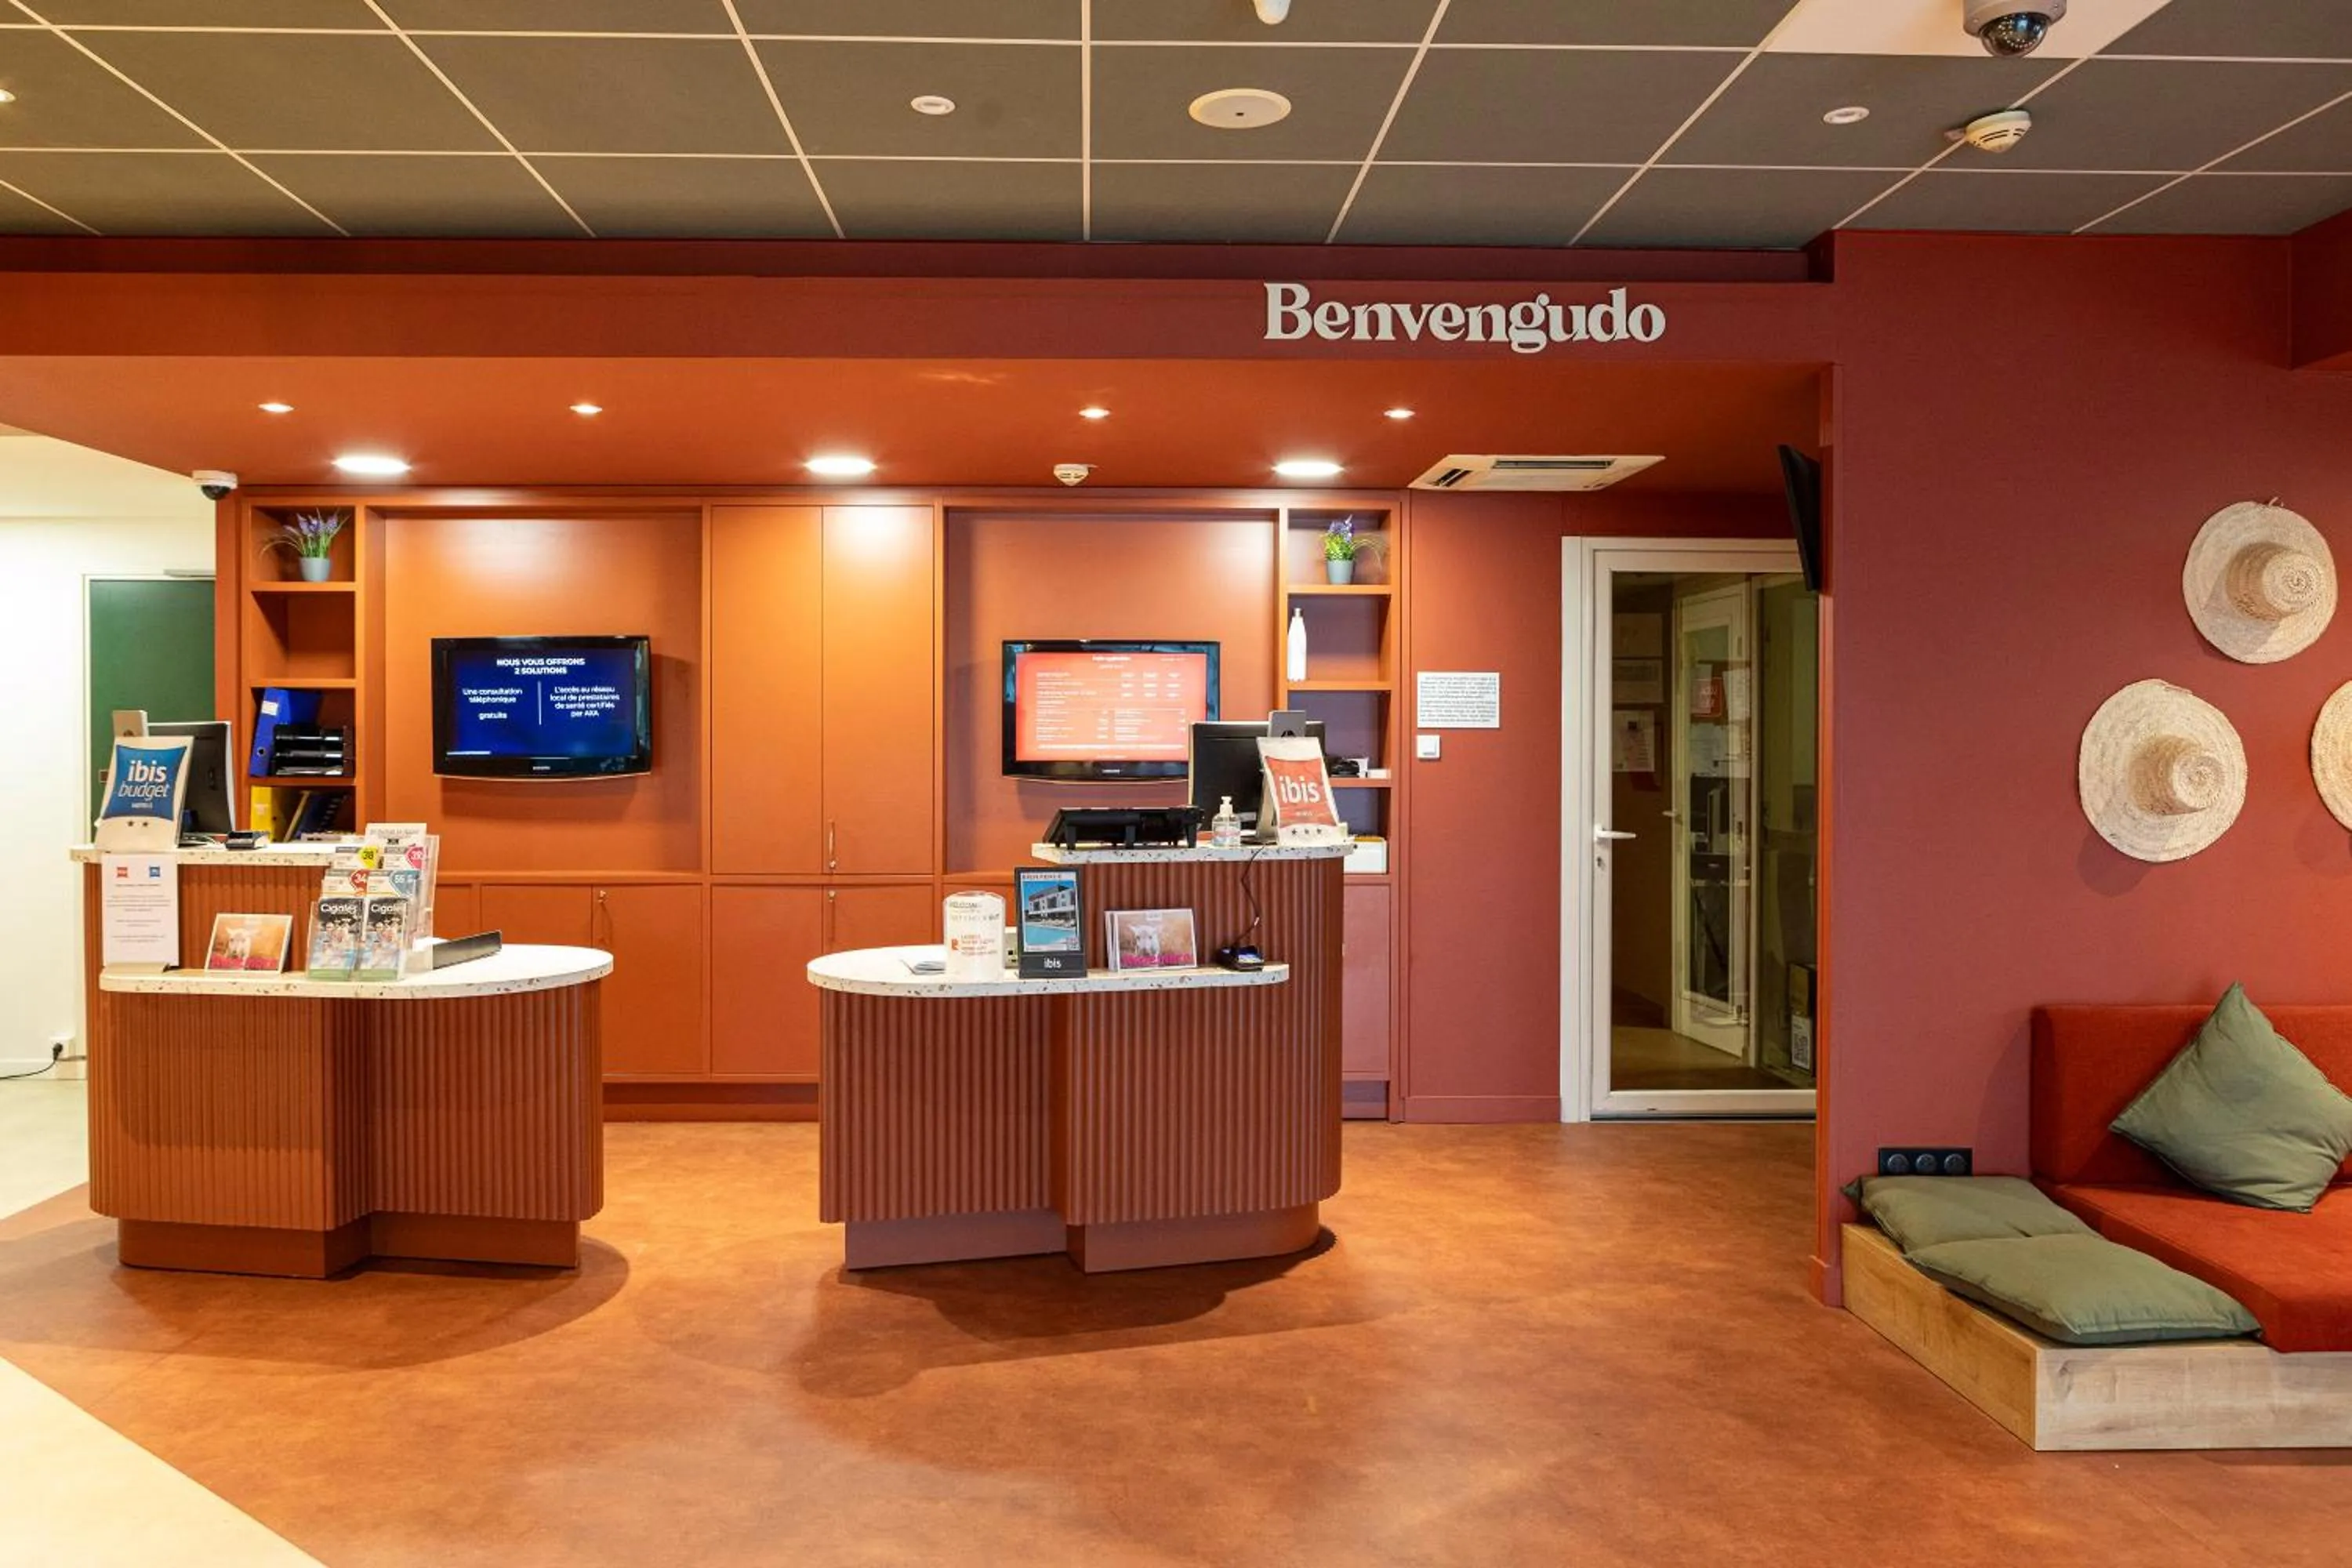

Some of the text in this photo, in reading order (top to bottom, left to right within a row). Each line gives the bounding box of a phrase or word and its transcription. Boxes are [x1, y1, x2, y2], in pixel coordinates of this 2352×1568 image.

[1263, 282, 1666, 354] Benvengudo
[127, 760, 168, 782] ibis
[118, 782, 170, 800] budget
[1279, 775, 1321, 804] ibis
[362, 851, 374, 860] 38
[355, 874, 366, 884] 34
[1044, 958, 1062, 969] ibis
